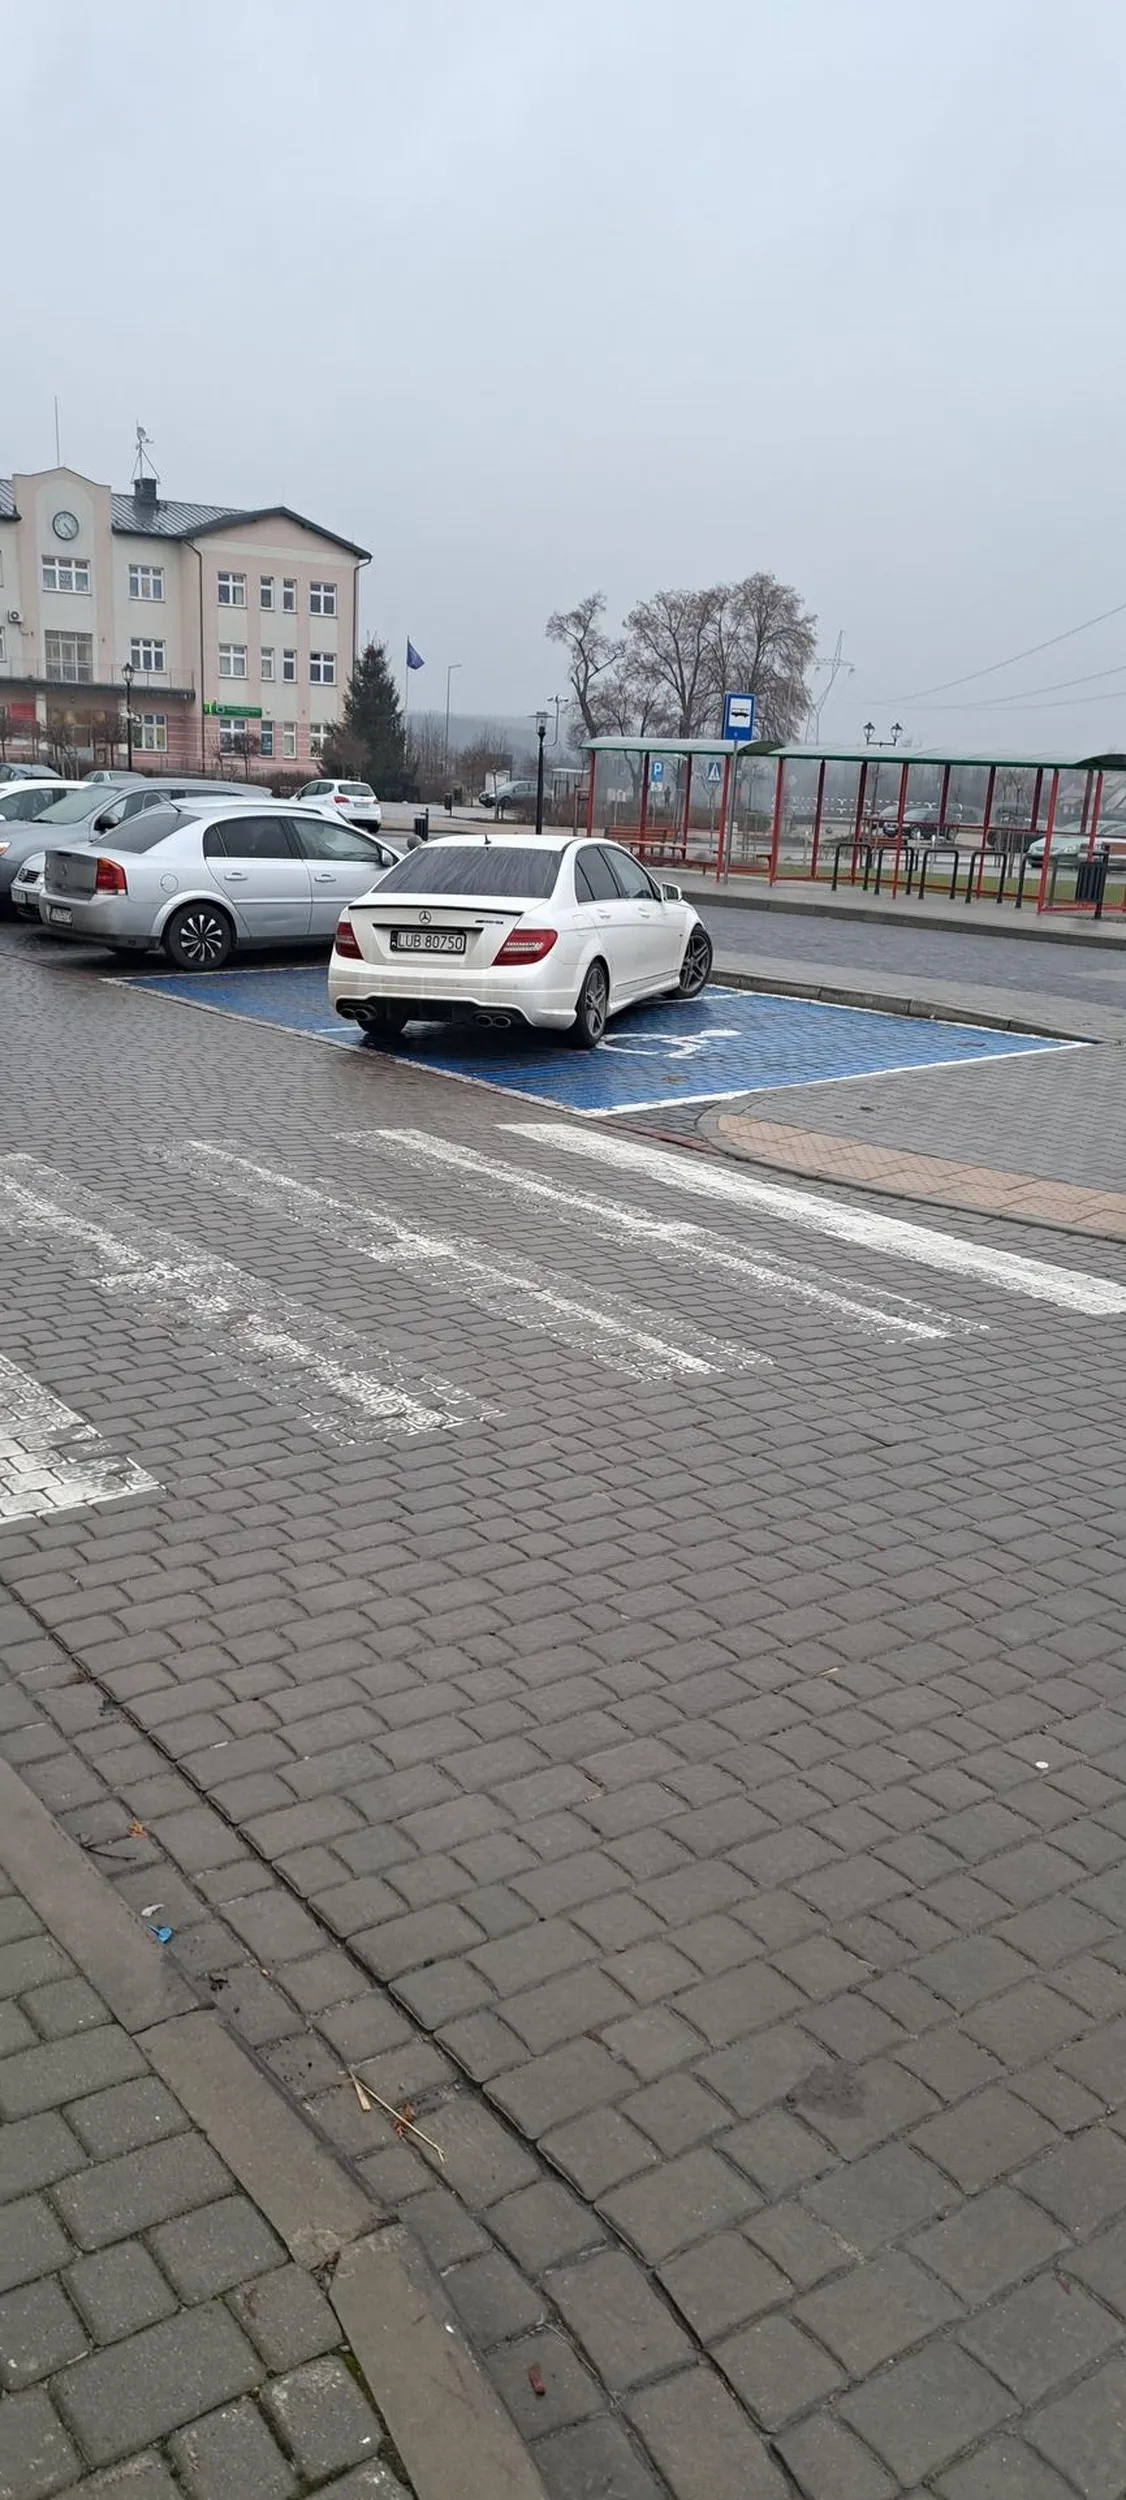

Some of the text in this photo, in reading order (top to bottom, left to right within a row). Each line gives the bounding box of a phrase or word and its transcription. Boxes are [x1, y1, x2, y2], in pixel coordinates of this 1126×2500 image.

[654, 762, 662, 775] P
[398, 933, 463, 950] LUB 80750
